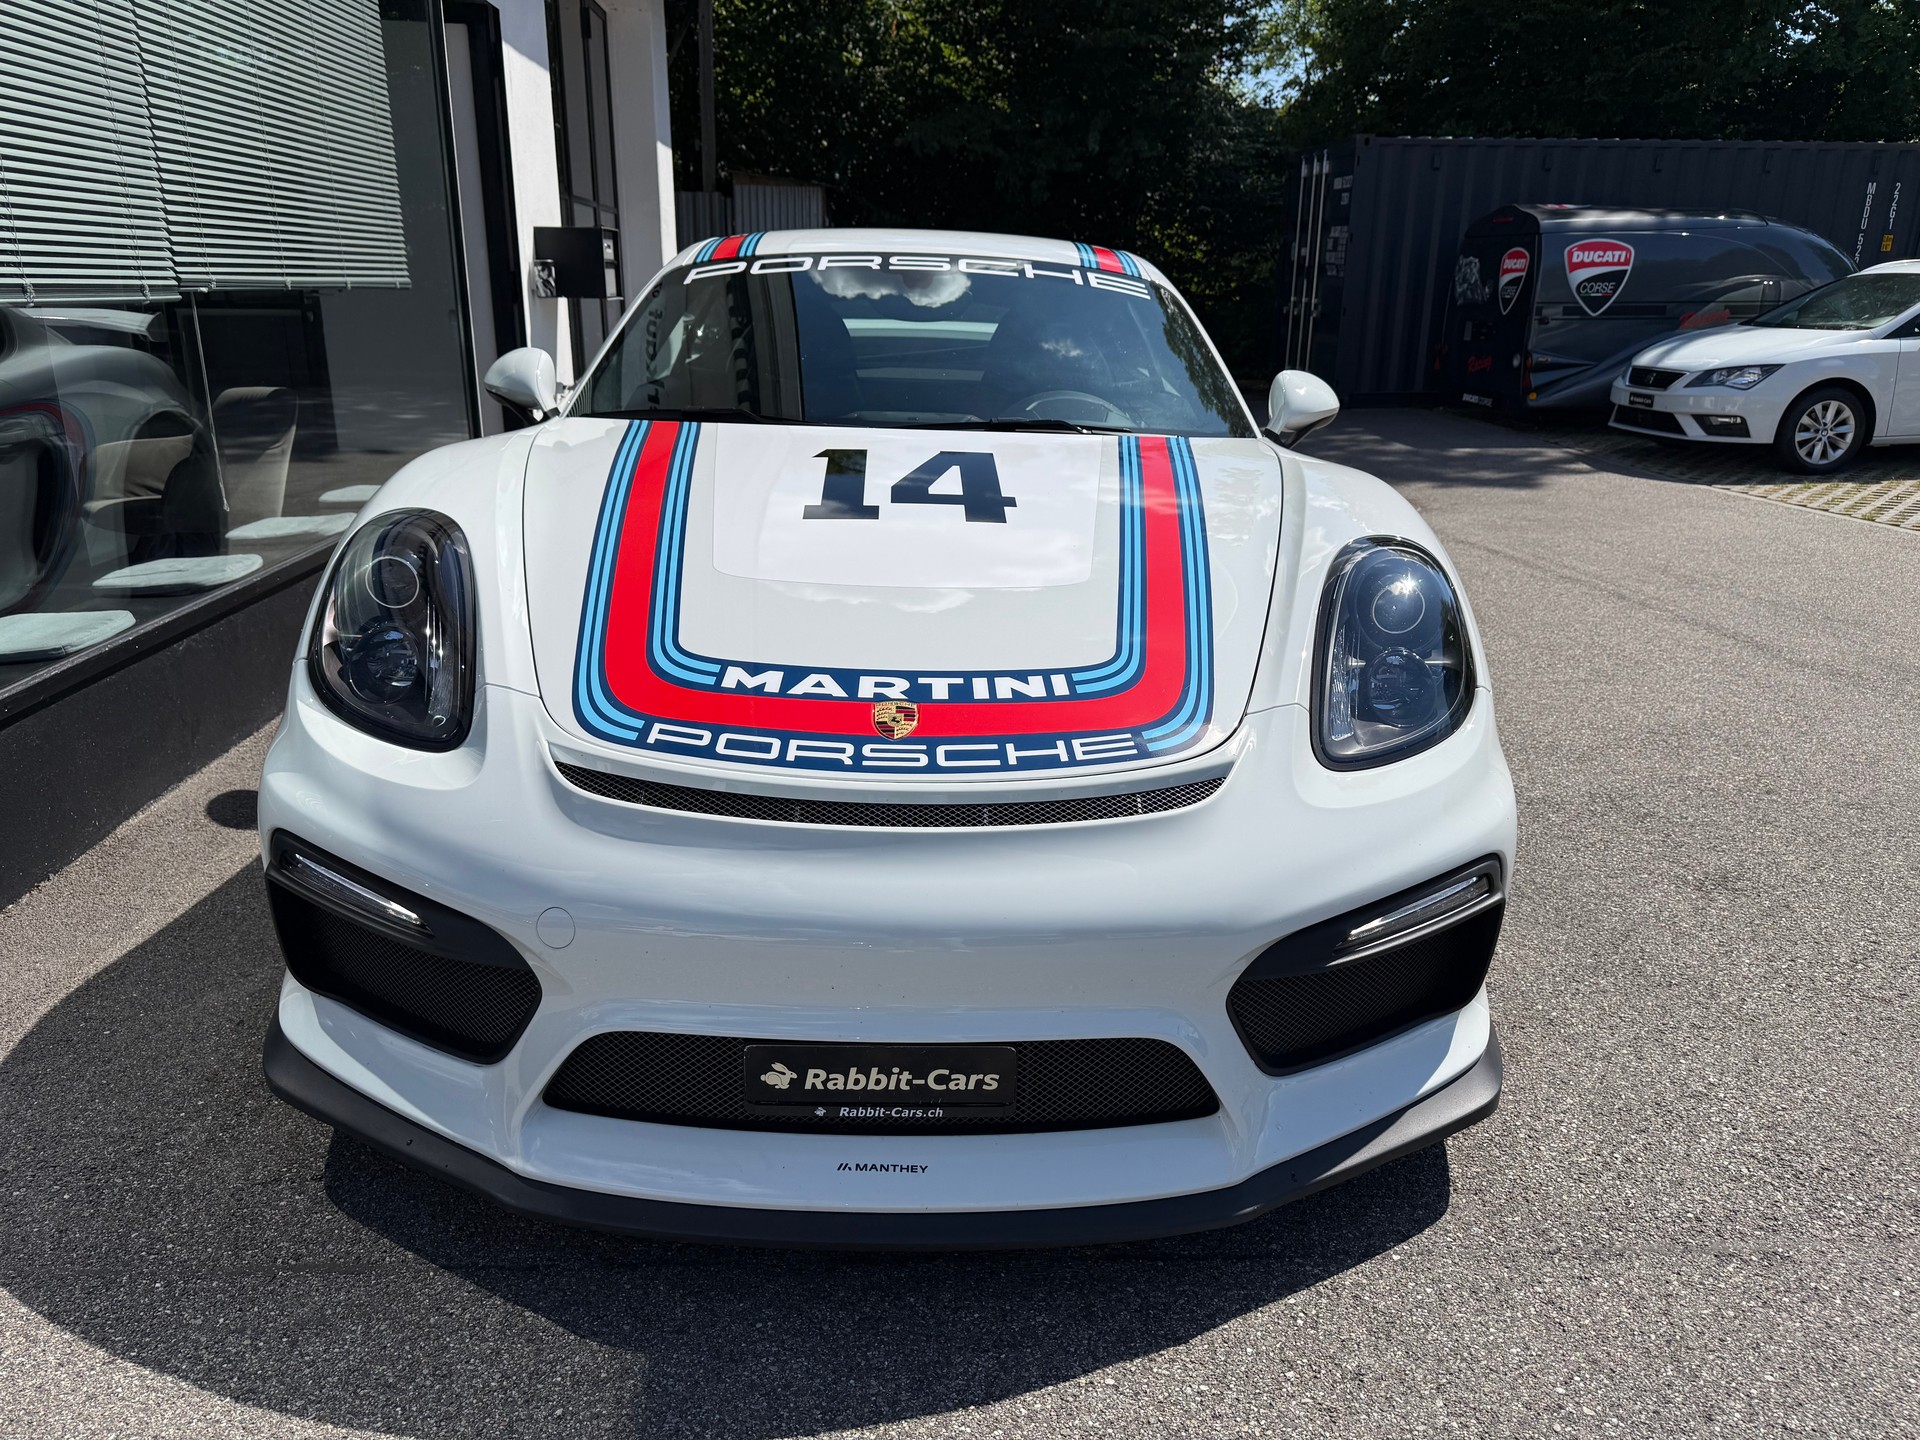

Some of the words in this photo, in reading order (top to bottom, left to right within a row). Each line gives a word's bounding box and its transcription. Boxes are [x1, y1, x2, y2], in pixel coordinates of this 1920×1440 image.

[1860, 182, 1877, 230] MBDU
[1888, 182, 1902, 230] 22G1
[1503, 258, 1526, 270] DUCATI
[1571, 251, 1627, 263] DUCATI
[684, 255, 1151, 299] PORSCHE
[1579, 282, 1616, 294] CORSE
[802, 449, 1017, 524] 14
[720, 666, 1070, 700] MARTINI
[646, 722, 1138, 768] PORSCHE
[804, 1067, 1000, 1091] Rabbit-Cars
[839, 1107, 944, 1118] Rabbit-Cars.ch
[855, 1163, 929, 1174] MANTHEY
